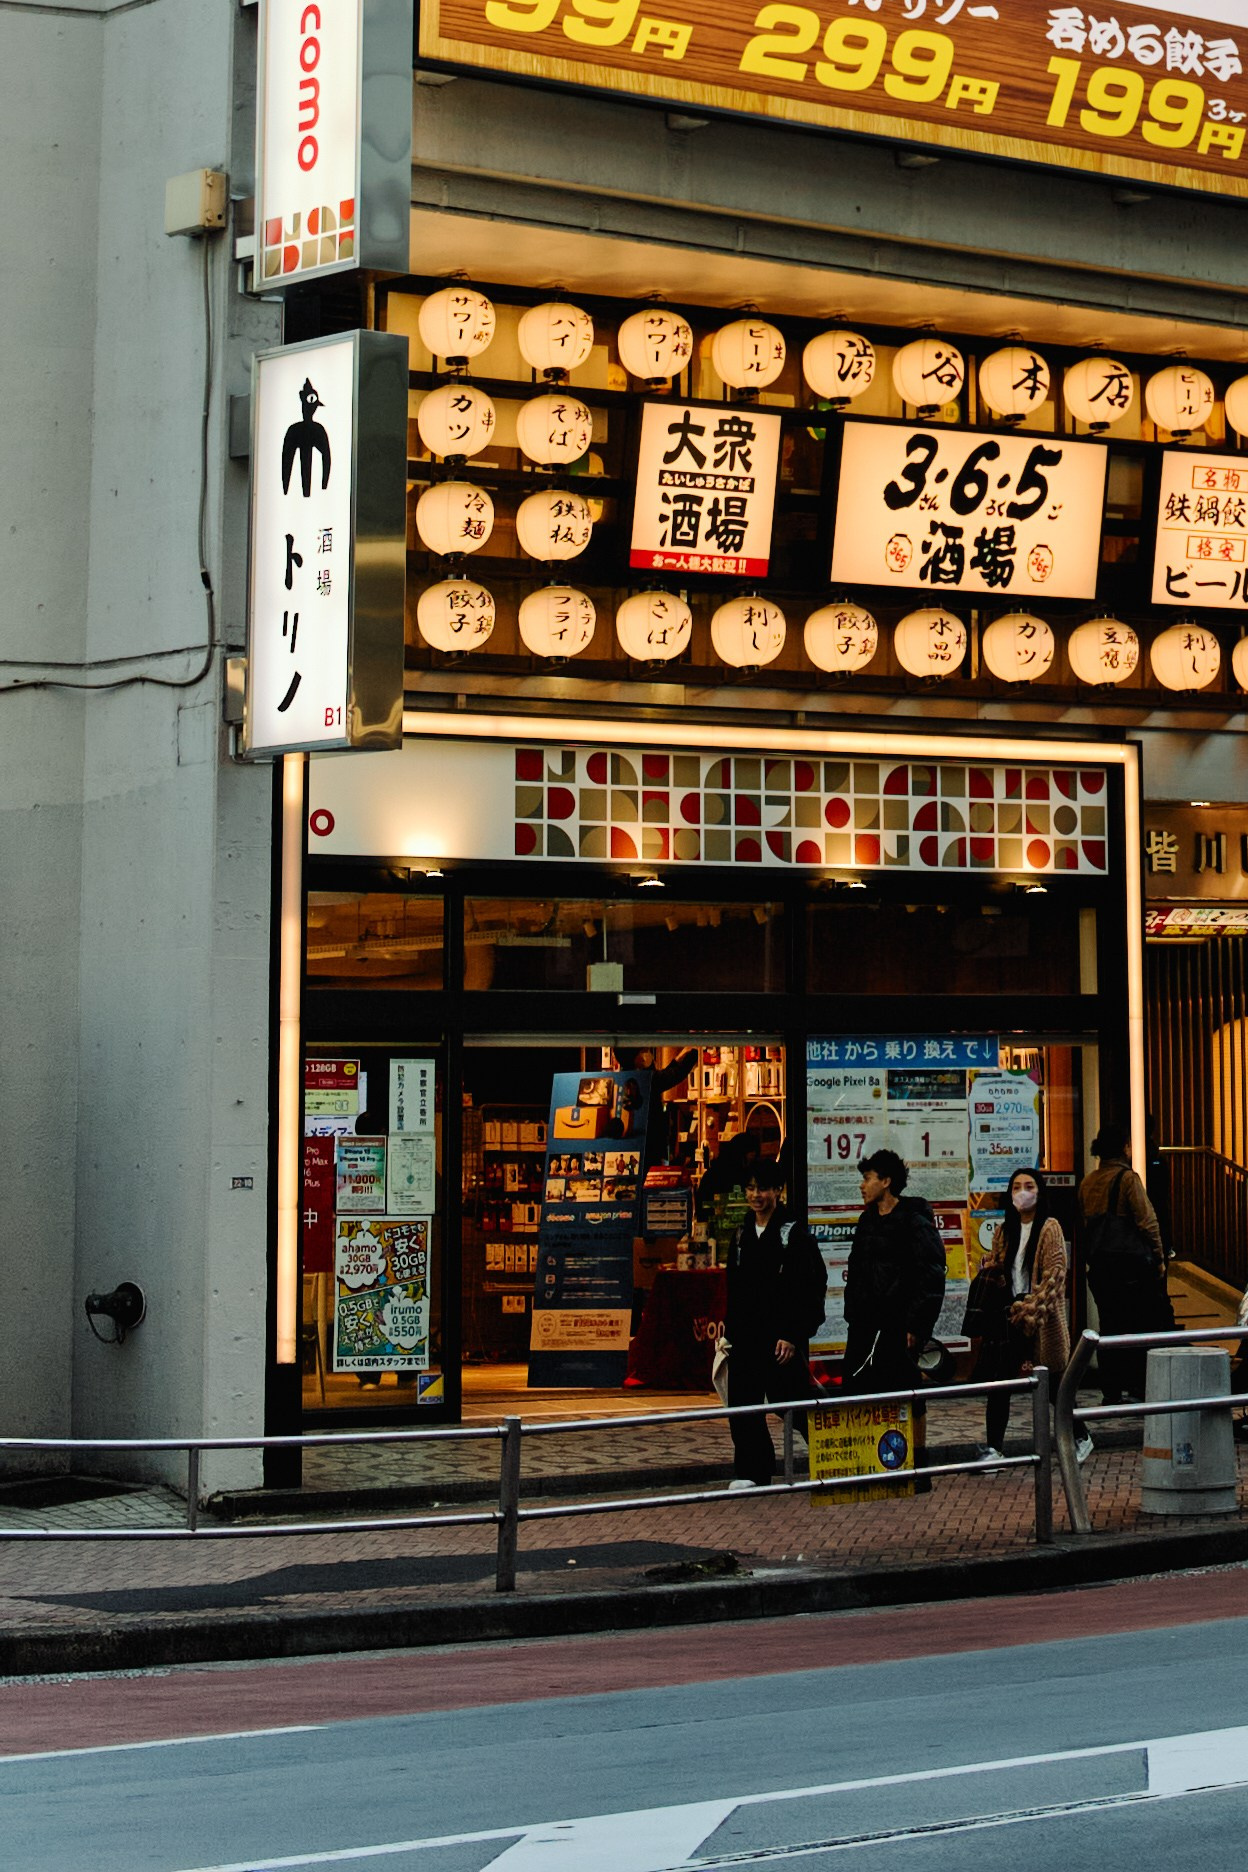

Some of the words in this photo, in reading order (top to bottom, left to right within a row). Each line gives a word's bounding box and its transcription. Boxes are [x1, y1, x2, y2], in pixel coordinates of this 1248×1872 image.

[739, 4, 1001, 114] 299円
[1046, 8, 1243, 81] 呑める餃子
[452, 295, 474, 341] サワー
[552, 317, 576, 348] ハイ
[645, 316, 668, 364] サワー
[744, 327, 767, 374] ビール
[773, 342, 785, 361] 生
[1178, 373, 1197, 416] ビール
[1203, 387, 1213, 404] 生
[448, 394, 473, 442] カツ
[548, 404, 575, 448] そば
[662, 409, 757, 474] 大衆
[661, 472, 755, 493] たいしゅうさかば
[1201, 466, 1240, 490] 名物
[550, 499, 577, 545] 鉄板
[658, 491, 750, 555] 酒場
[316, 527, 333, 596] 酒場
[919, 519, 1017, 589] 酒場
[1196, 537, 1238, 561] 格安
[277, 533, 304, 713] トリノ
[447, 589, 475, 633] 餃子
[552, 596, 572, 641] フライ
[647, 599, 671, 646] さば
[743, 606, 770, 652] 刺し
[834, 611, 860, 656] 餃子
[1016, 622, 1038, 665] カツ
[1100, 627, 1123, 669] 豆腐
[1182, 632, 1206, 674] 刺し
[325, 706, 342, 727] B1
[806, 1040, 839, 1061] 他社
[845, 1041, 878, 1061] から
[884, 1040, 917, 1061] 乗り
[923, 1040, 957, 1060] 換え
[962, 1042, 979, 1060] で
[807, 1076, 841, 1090] Google
[844, 1075, 867, 1086] Pixel
[868, 1076, 880, 1087] 8a
[306, 1146, 319, 1156] Pro
[312, 1155, 328, 1166] Max
[921, 1131, 930, 1158] 1
[304, 1177, 320, 1188] Plus
[341, 1243, 377, 1254] ahamo
[347, 1254, 371, 1264] 30GB
[391, 1251, 427, 1271] 30GB
[394, 1236, 420, 1256] 安く
[390, 1304, 423, 1316] irumo
